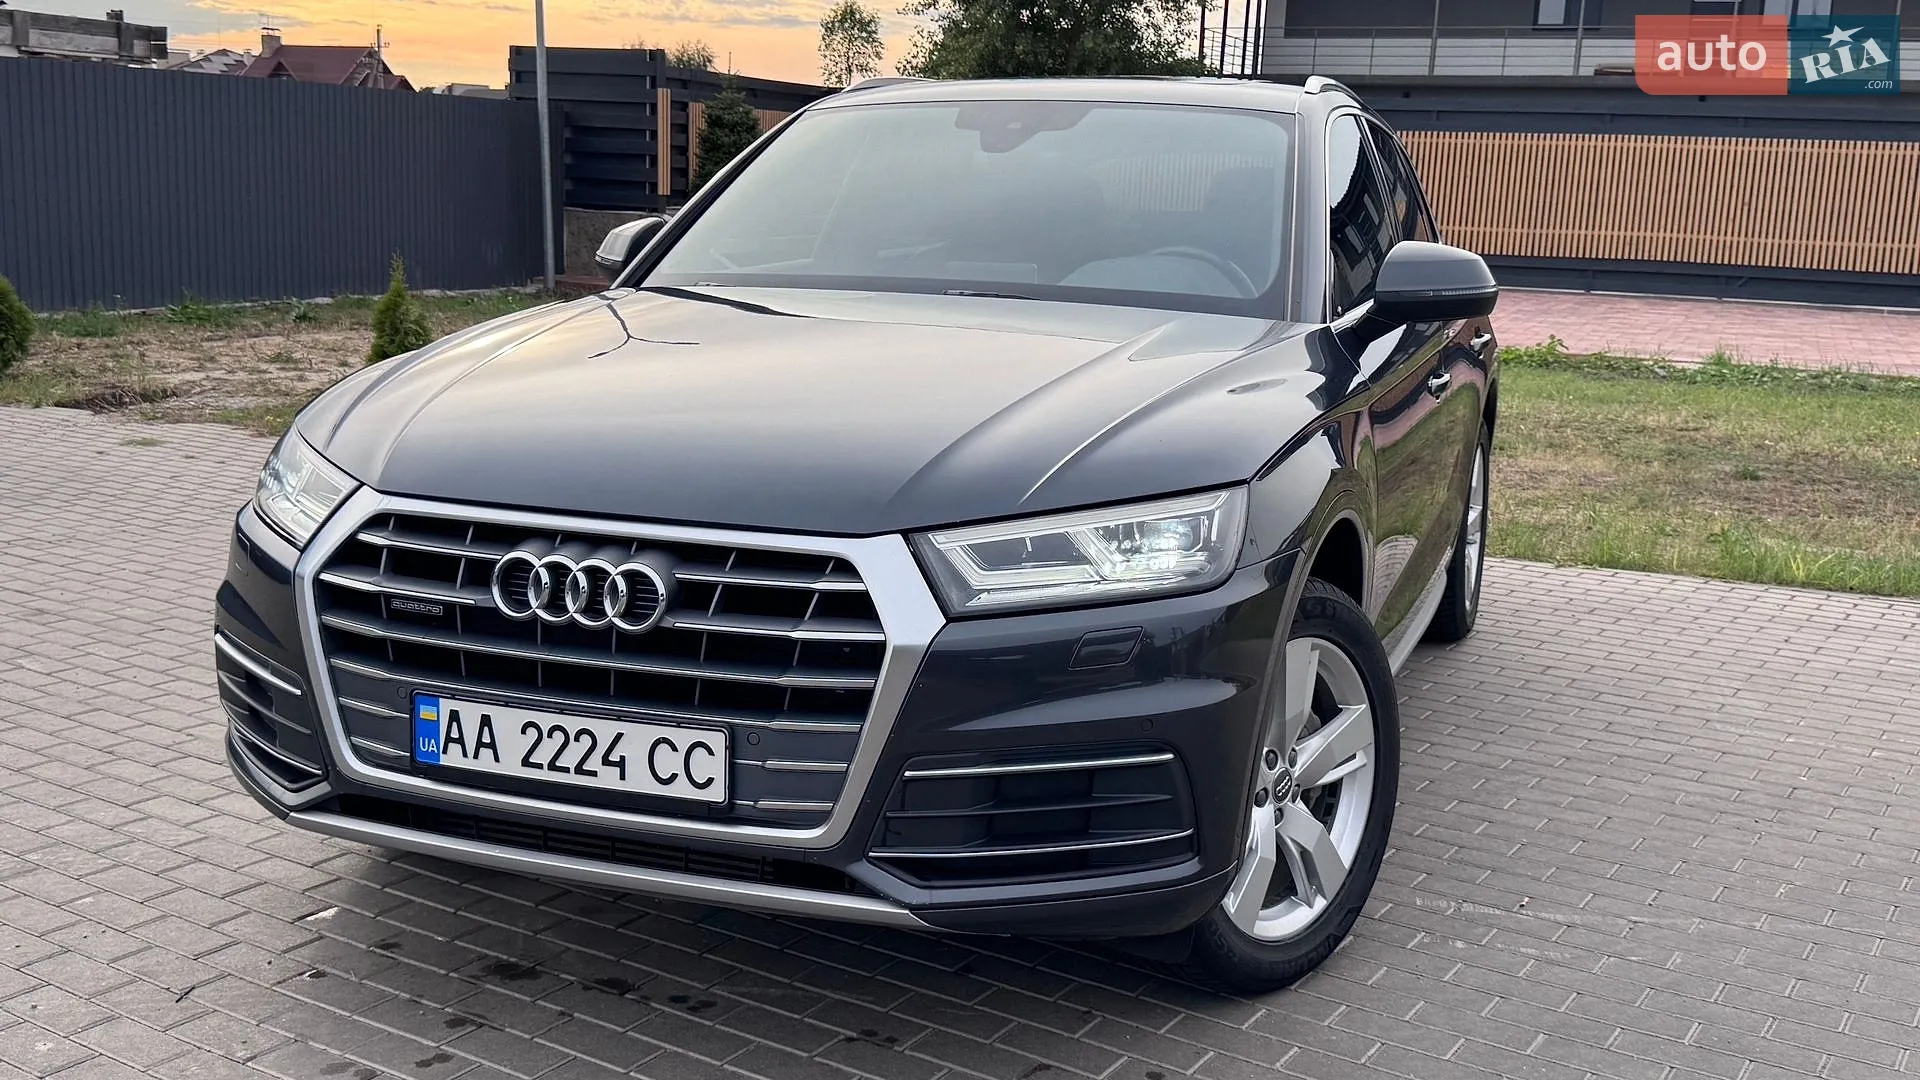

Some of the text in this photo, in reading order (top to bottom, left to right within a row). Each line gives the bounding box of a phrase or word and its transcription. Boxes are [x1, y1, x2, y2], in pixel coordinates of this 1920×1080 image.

[392, 601, 440, 613] quattro
[419, 736, 438, 754] UA
[441, 708, 716, 790] AA 2224 CC
